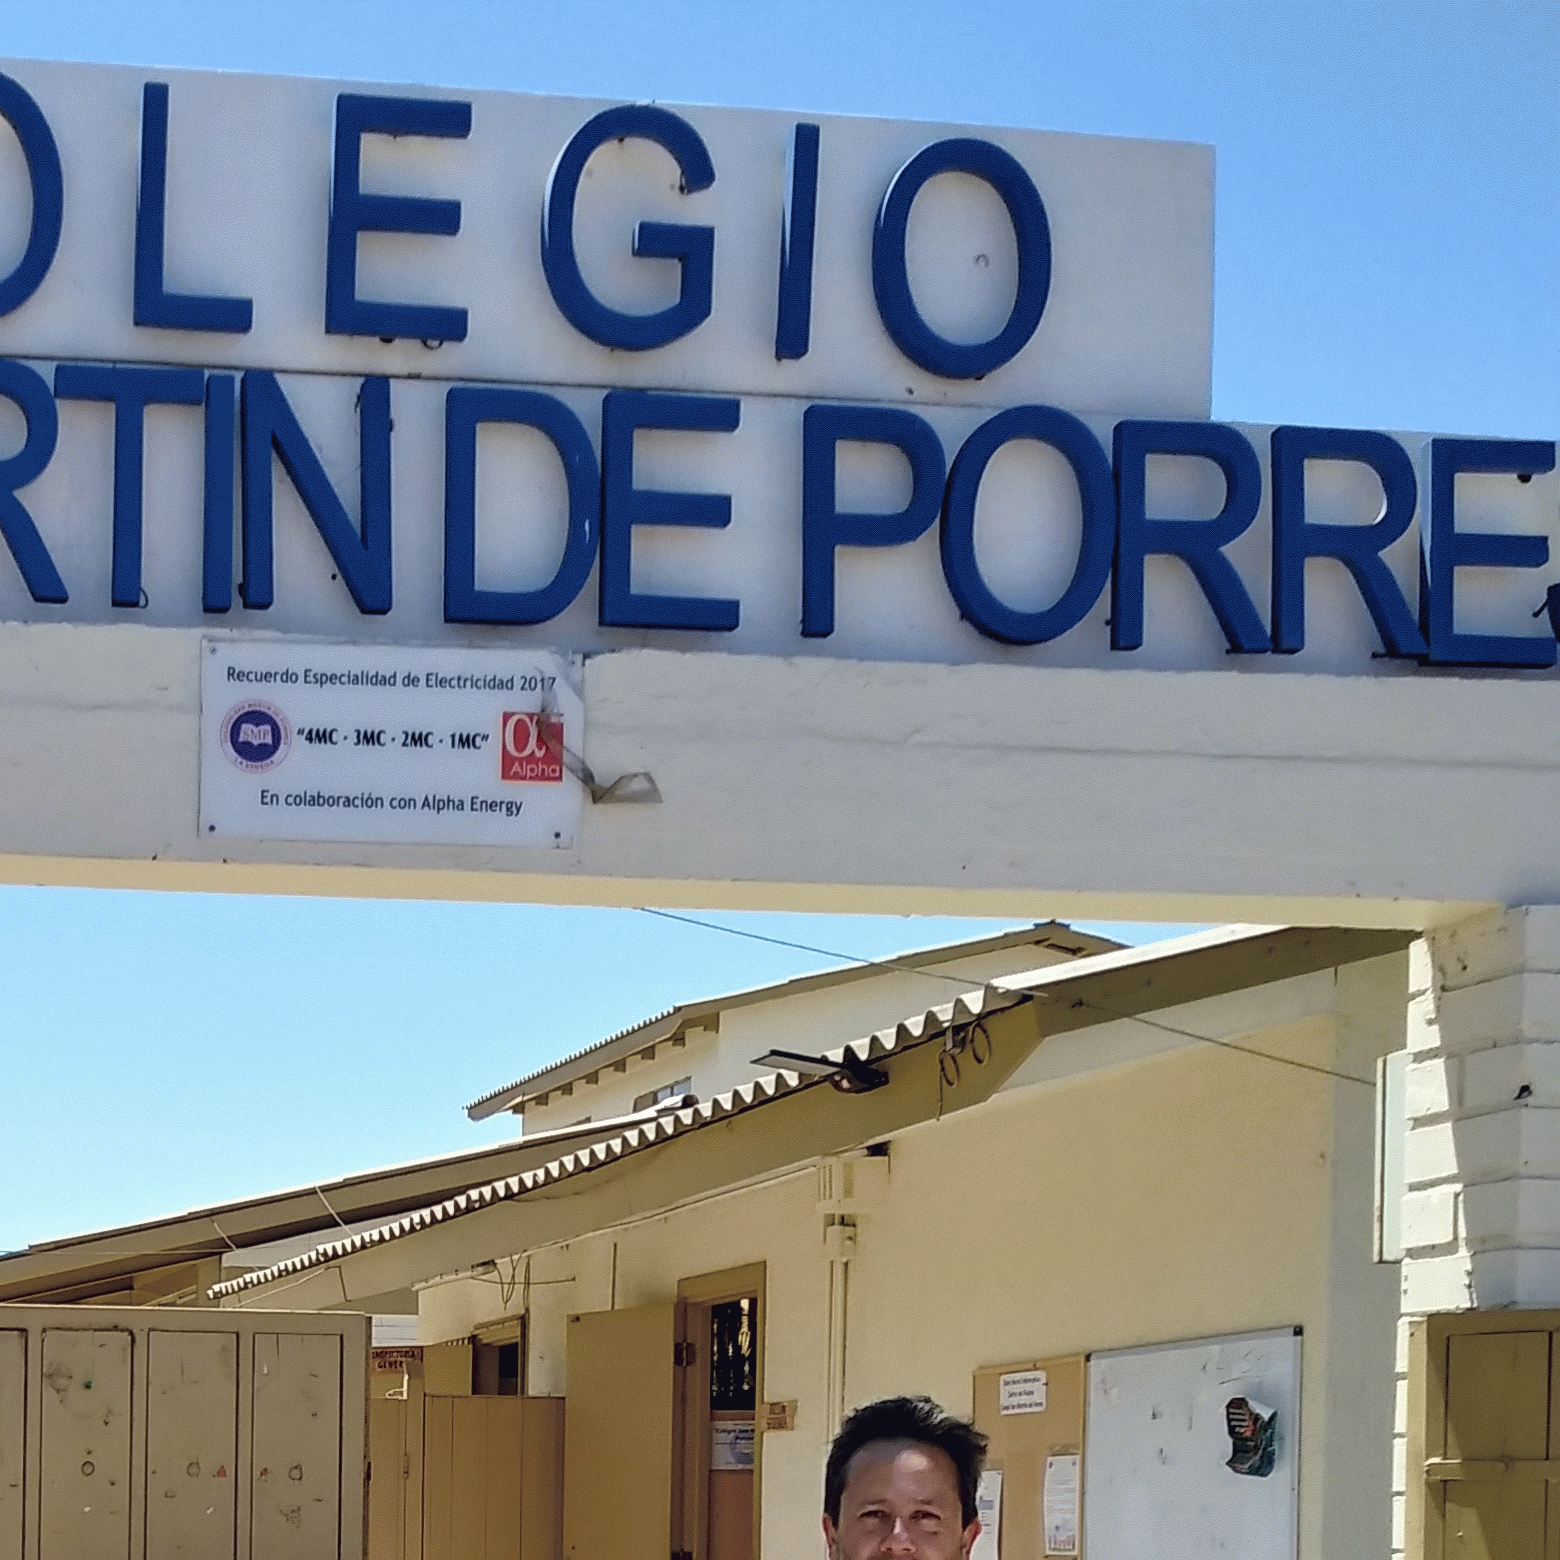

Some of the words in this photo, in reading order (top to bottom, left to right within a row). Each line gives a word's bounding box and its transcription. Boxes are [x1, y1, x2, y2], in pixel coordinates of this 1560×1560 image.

[444, 387, 741, 632] DE
[800, 402, 1560, 668] PORRE
[227, 666, 299, 684] Recuerdo
[304, 668, 397, 688] Especialidad
[402, 671, 420, 687] de
[425, 672, 515, 690] Electricidad
[520, 676, 556, 692] 2017
[243, 727, 270, 741] SMP
[297, 728, 338, 746] "4MC
[354, 729, 386, 747] 3MC
[401, 730, 434, 748] 2MC
[450, 732, 490, 750] 1MC"
[510, 761, 560, 780] Alpha
[260, 789, 279, 806] En
[284, 791, 384, 810] colaboración
[389, 797, 417, 810] con
[421, 794, 465, 814] Alpha
[470, 796, 523, 817] Energy
